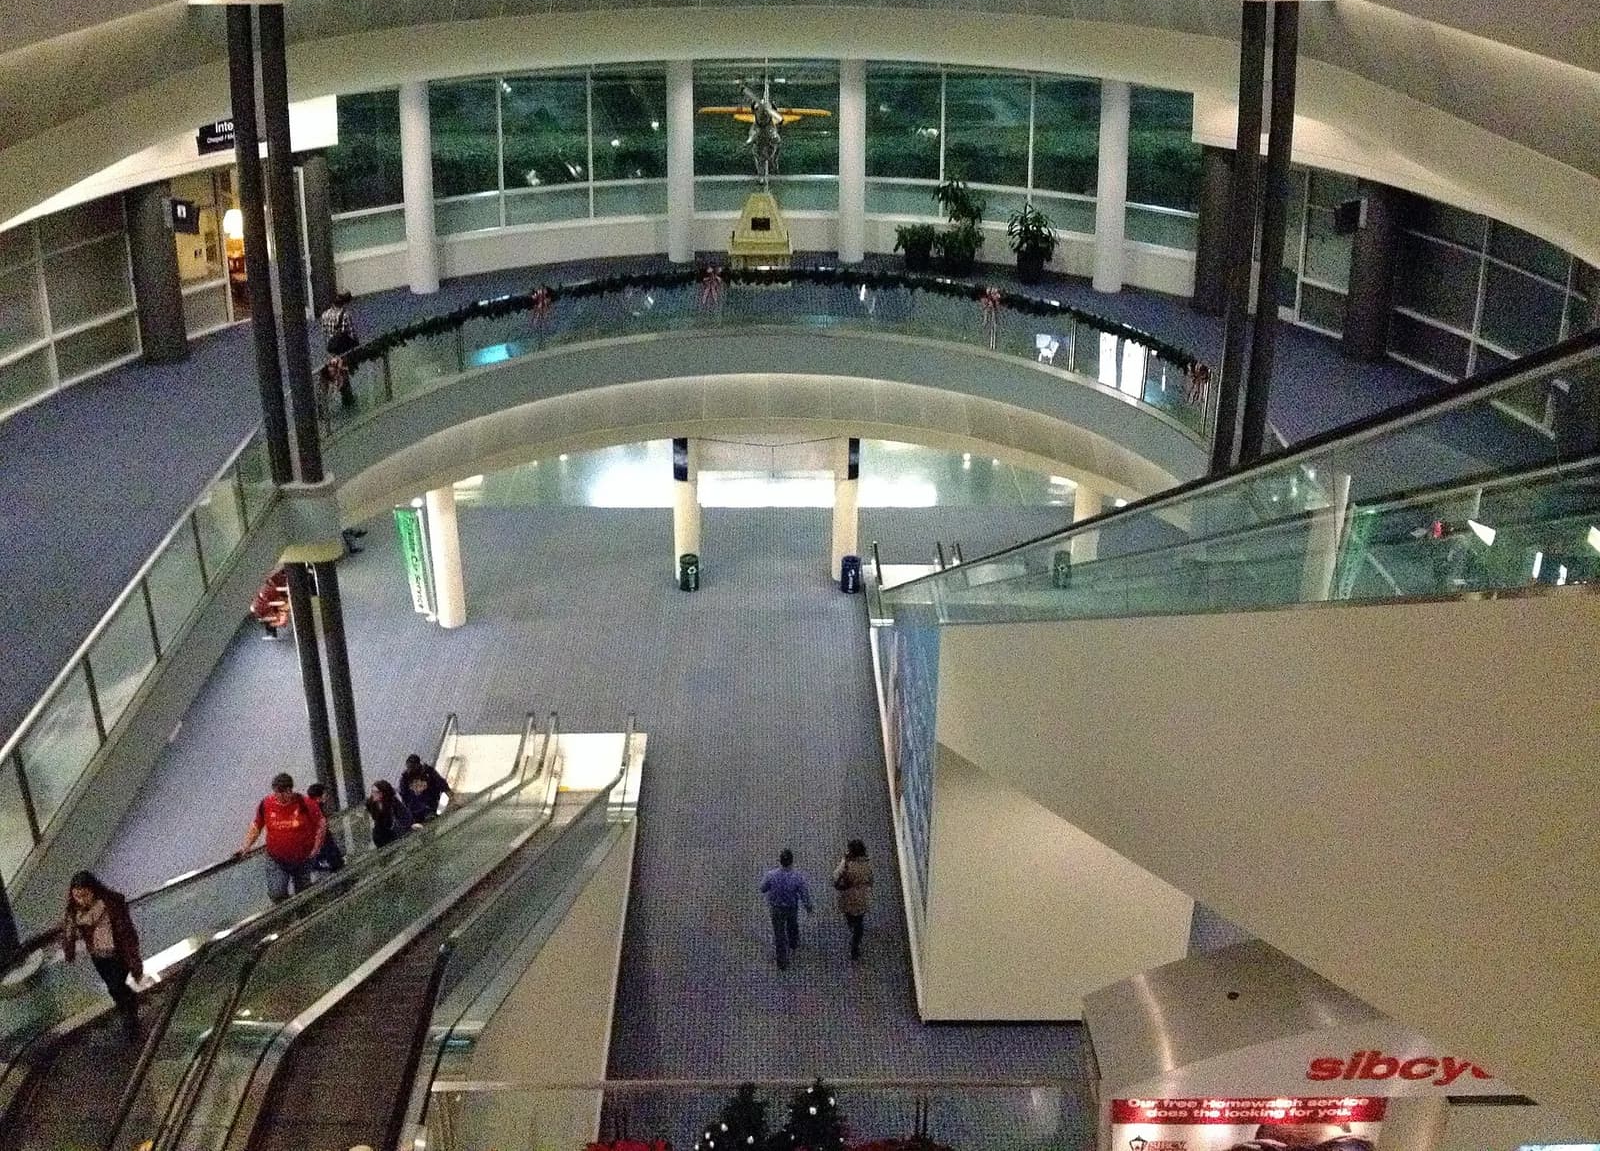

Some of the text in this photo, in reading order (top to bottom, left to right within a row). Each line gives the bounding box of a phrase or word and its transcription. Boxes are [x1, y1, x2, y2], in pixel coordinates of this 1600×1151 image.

[1128, 1097, 1369, 1108] Our free Homewatch service
[1146, 1108, 1188, 1118] does
[1193, 1109, 1221, 1118] the
[1225, 1109, 1287, 1119] looking
[1290, 1108, 1314, 1117] for
